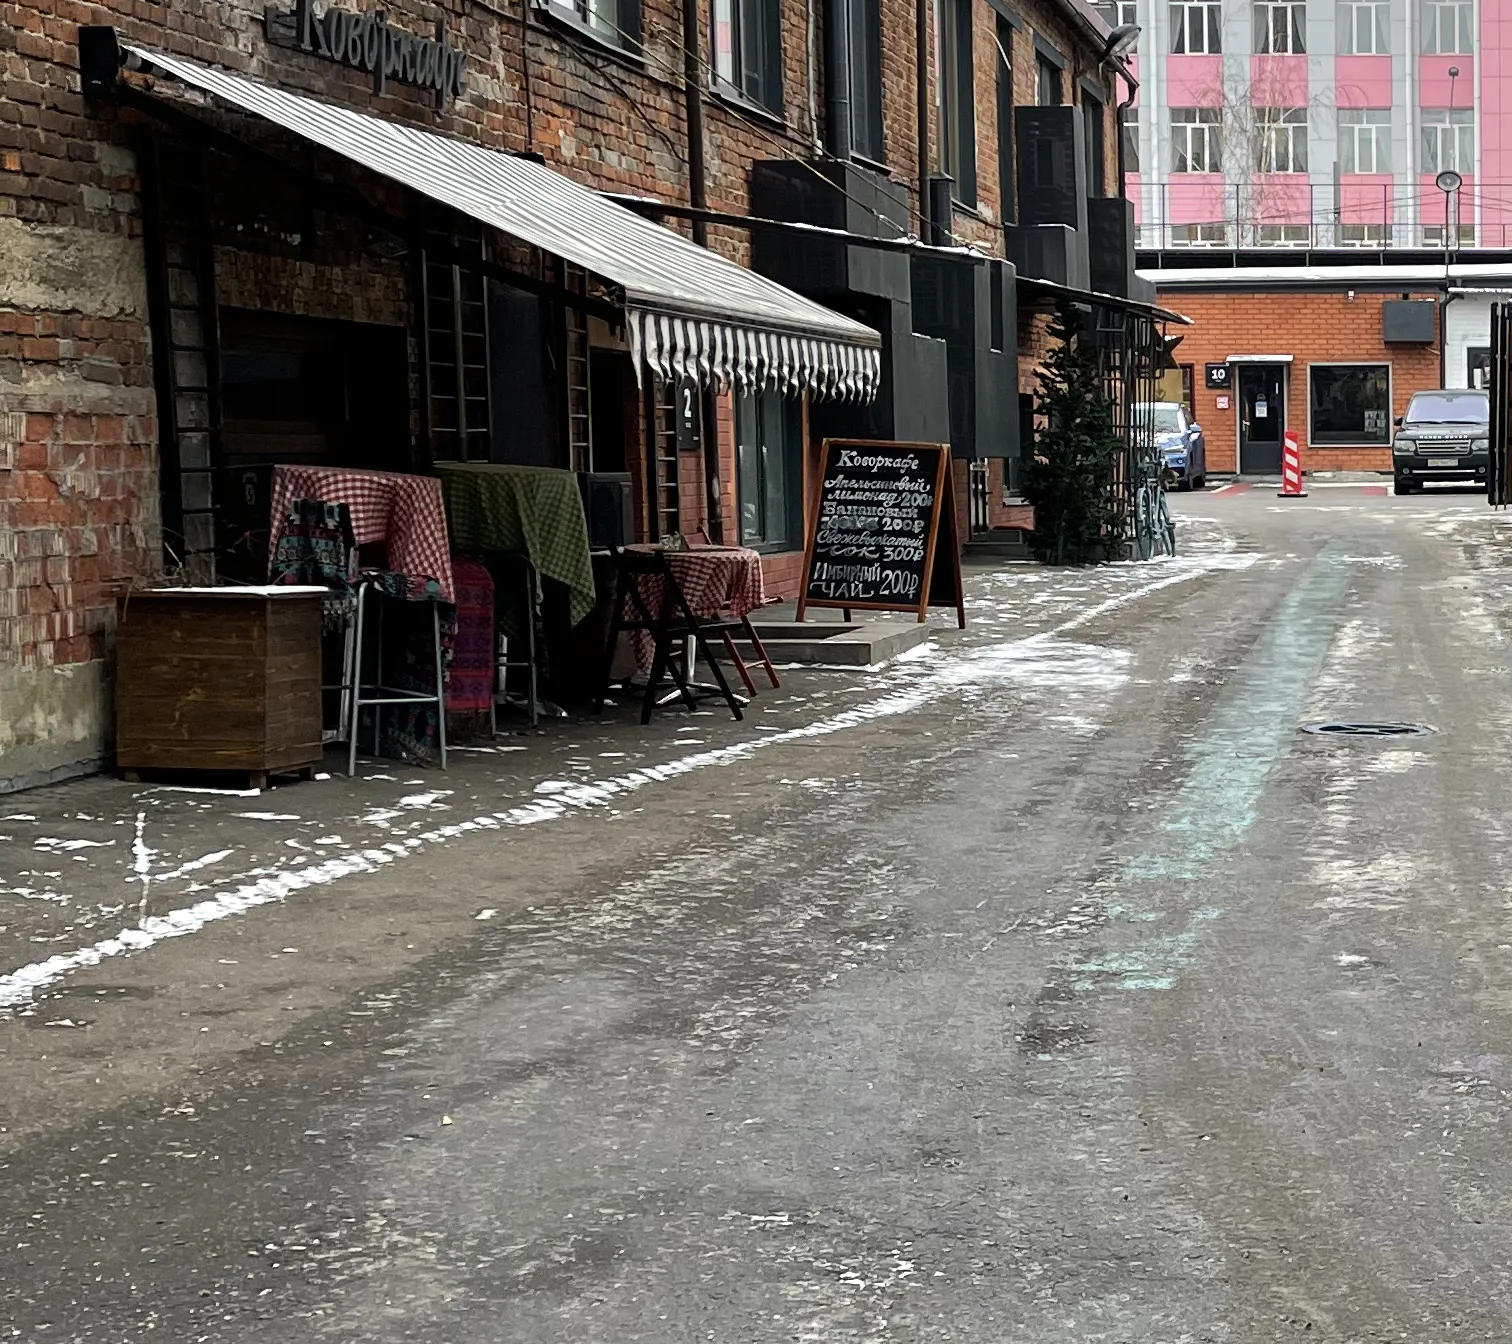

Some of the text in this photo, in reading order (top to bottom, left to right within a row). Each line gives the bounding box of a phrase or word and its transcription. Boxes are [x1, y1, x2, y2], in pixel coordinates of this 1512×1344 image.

[1211, 368, 1226, 380] 10
[683, 388, 692, 418] 2
[835, 450, 919, 473] Коворкафе
[824, 474, 931, 493] Апельсиновый
